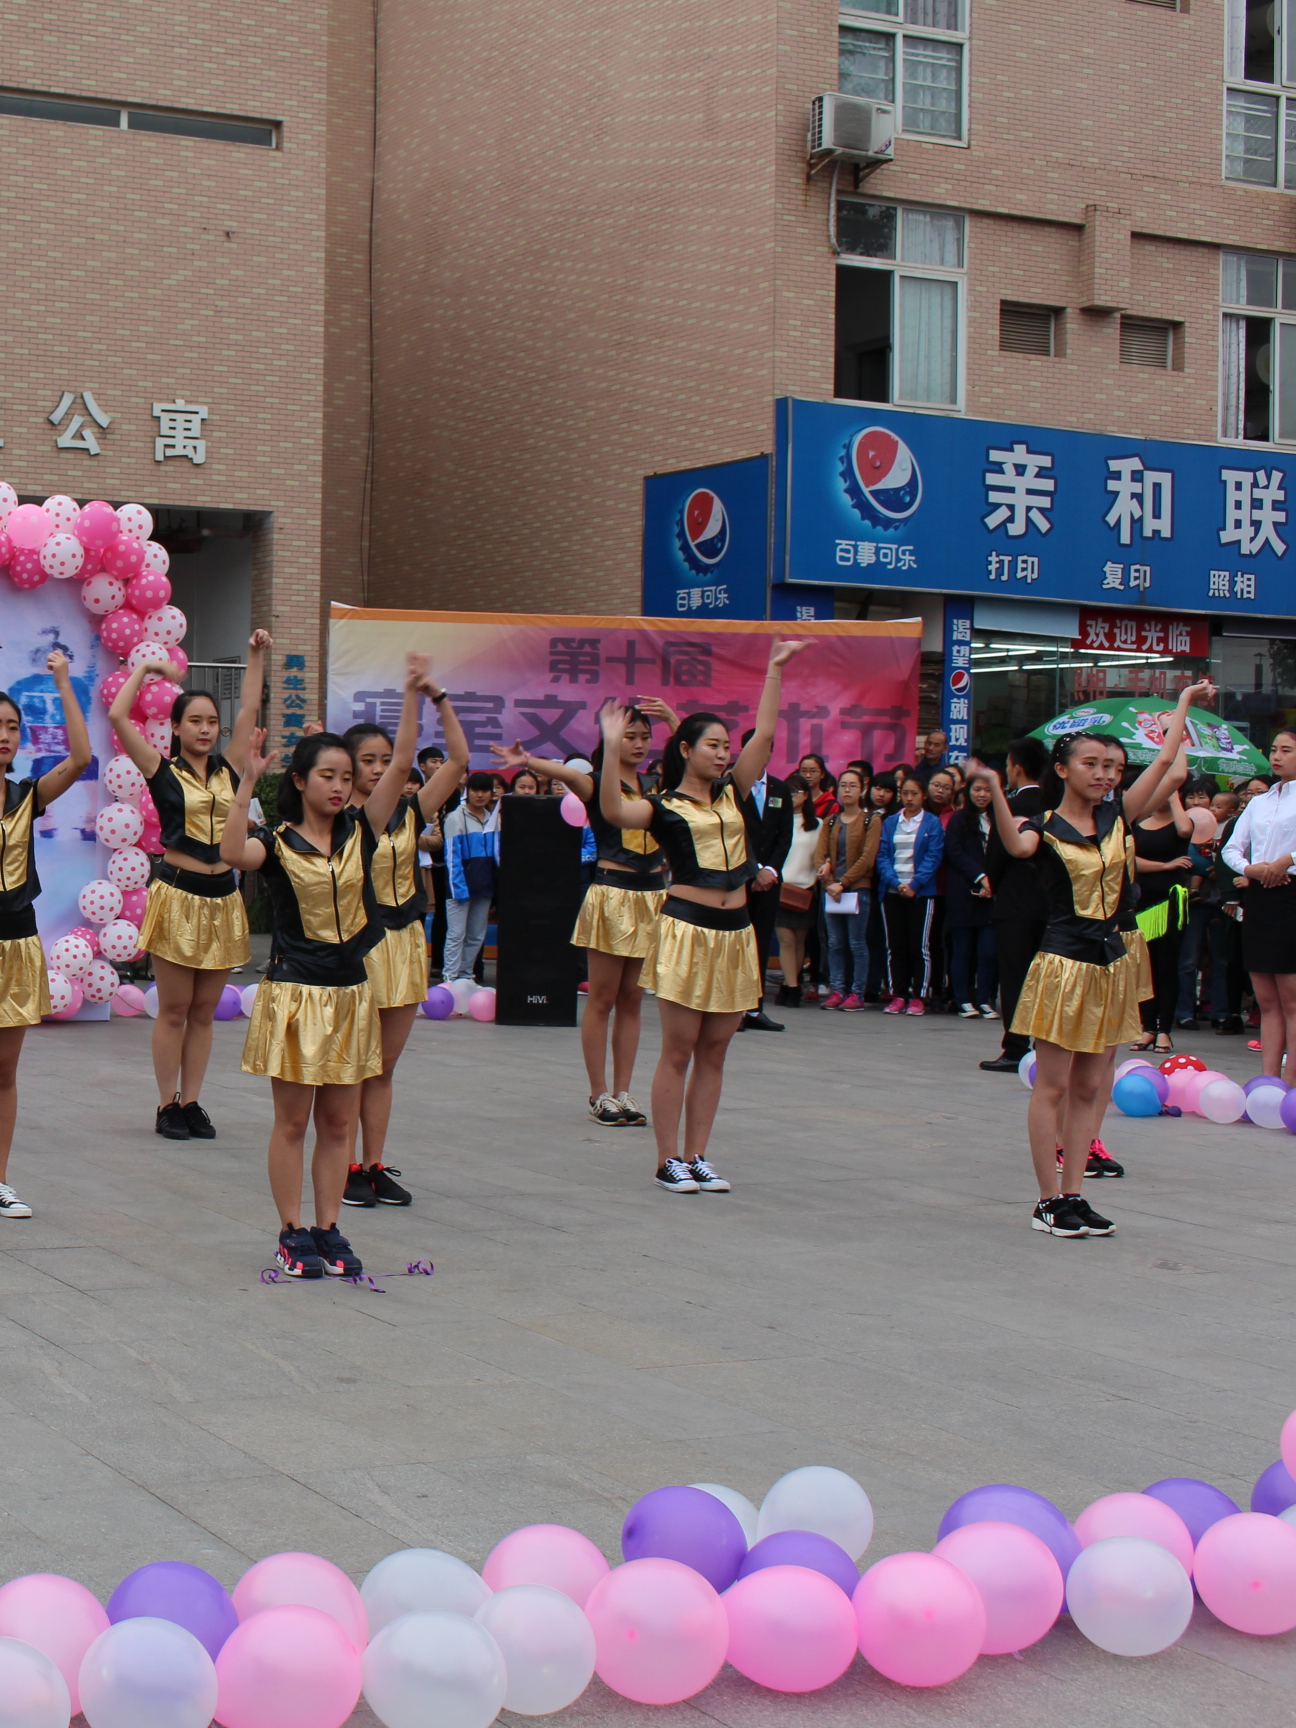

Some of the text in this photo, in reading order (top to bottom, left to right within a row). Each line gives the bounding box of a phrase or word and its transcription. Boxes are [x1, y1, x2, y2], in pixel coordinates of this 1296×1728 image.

[983, 443, 1288, 558] 亲和联
[835, 539, 918, 570] 百事可乐
[987, 551, 1256, 600] 打印 复印 照相
[676, 584, 730, 612] 百事可乐
[1085, 617, 1192, 653] 欢迎光临
[549, 636, 713, 688] 第十届
